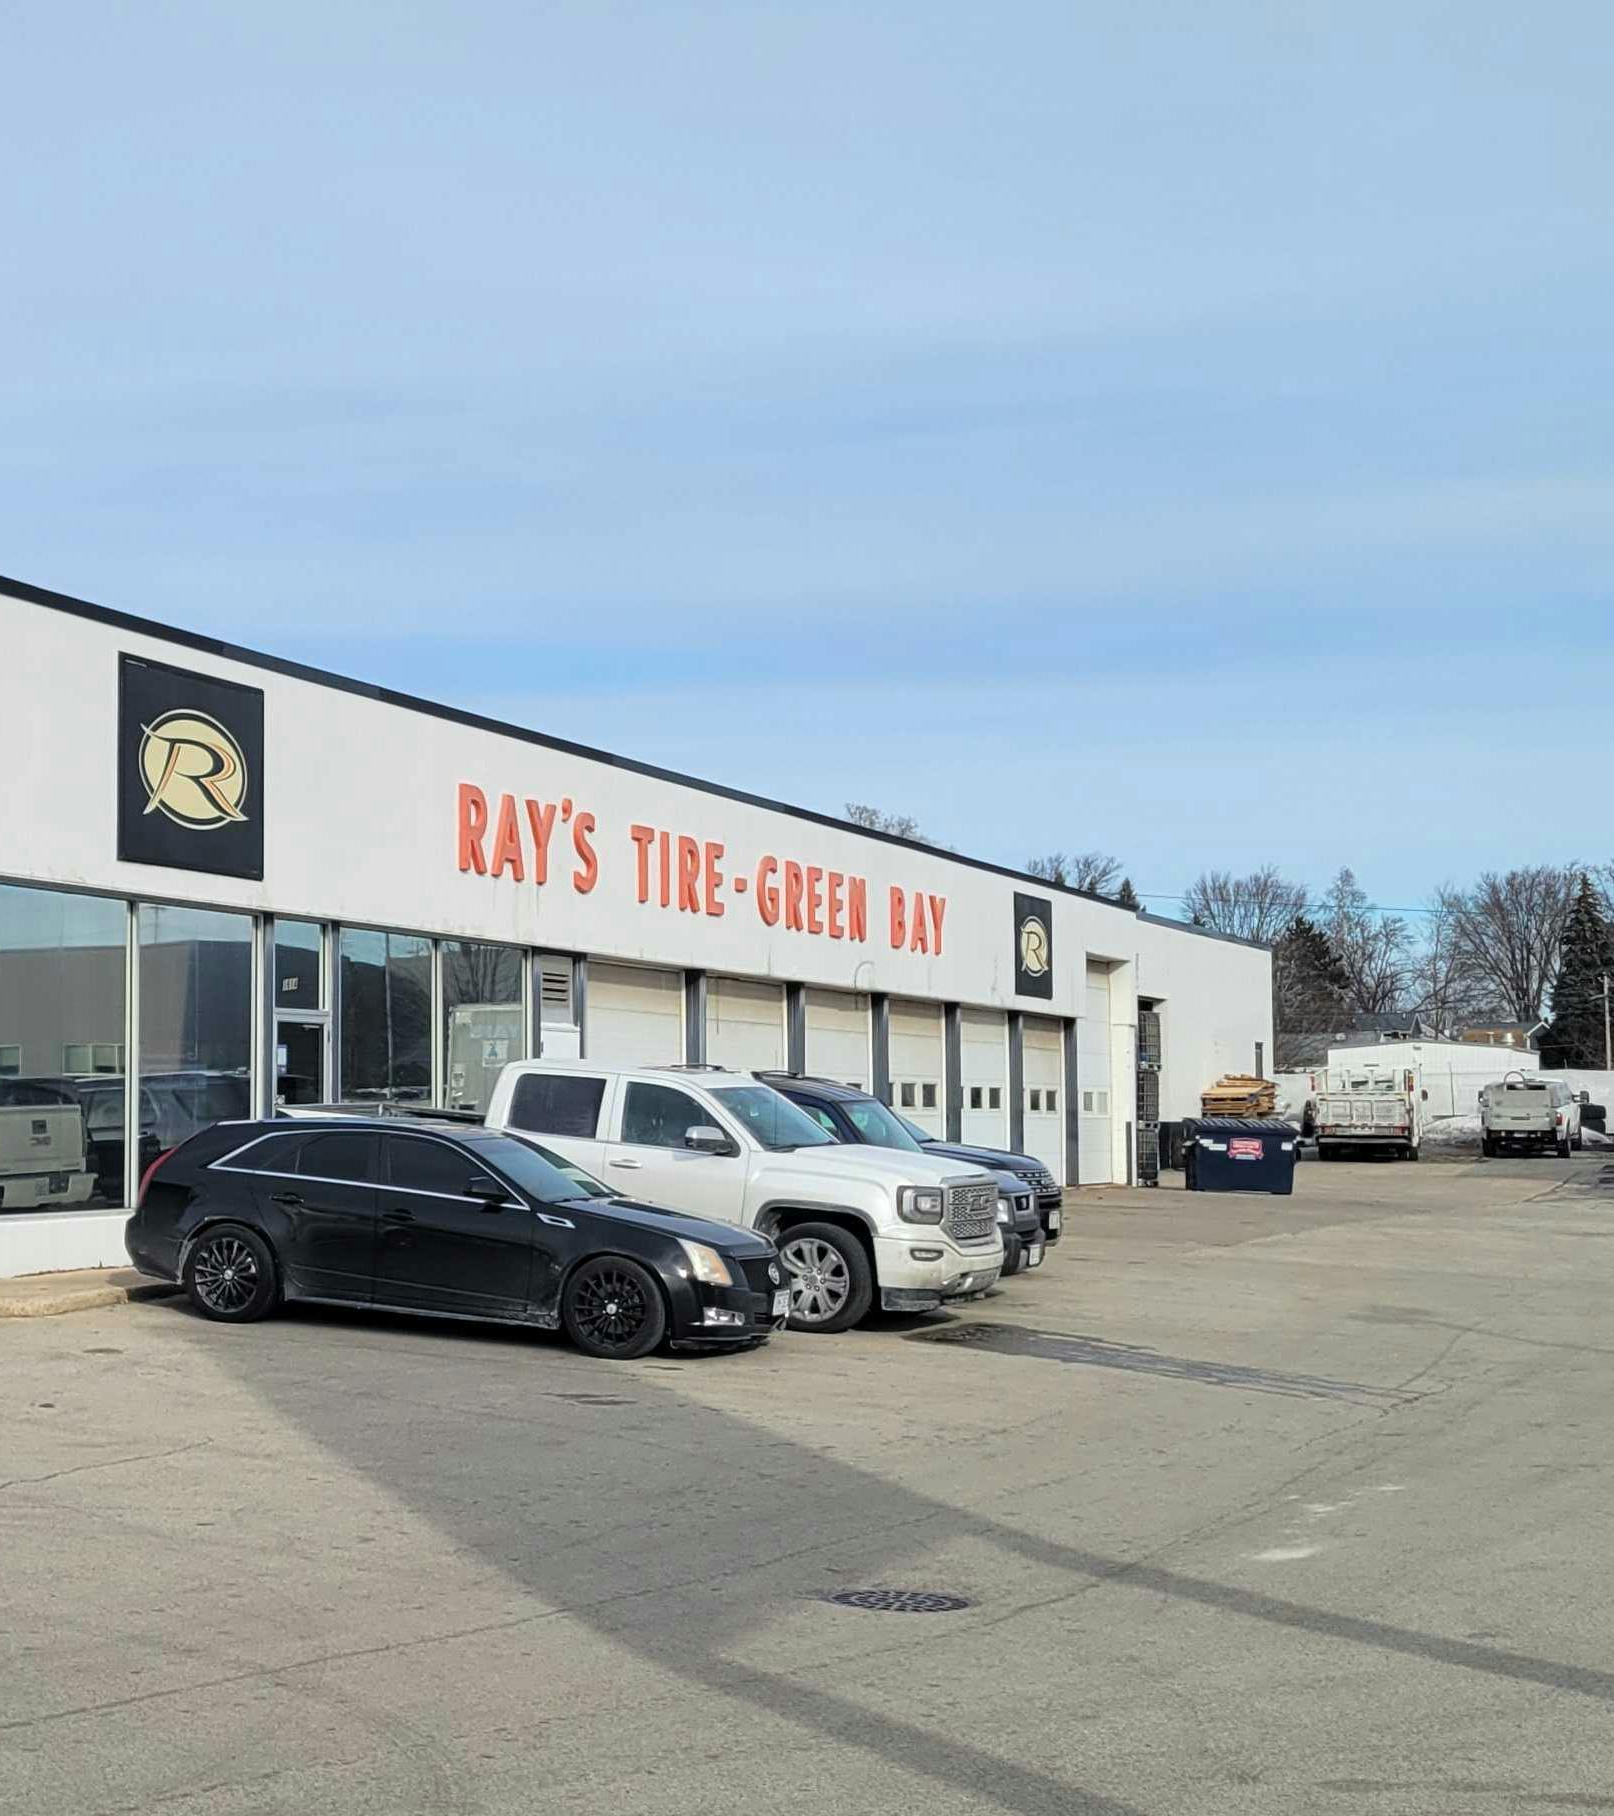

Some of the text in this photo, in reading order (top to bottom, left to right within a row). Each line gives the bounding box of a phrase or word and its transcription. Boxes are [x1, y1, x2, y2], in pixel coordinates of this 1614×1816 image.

[140, 722, 249, 822] R
[458, 783, 598, 894] RAY'S
[889, 886, 947, 956] BAY
